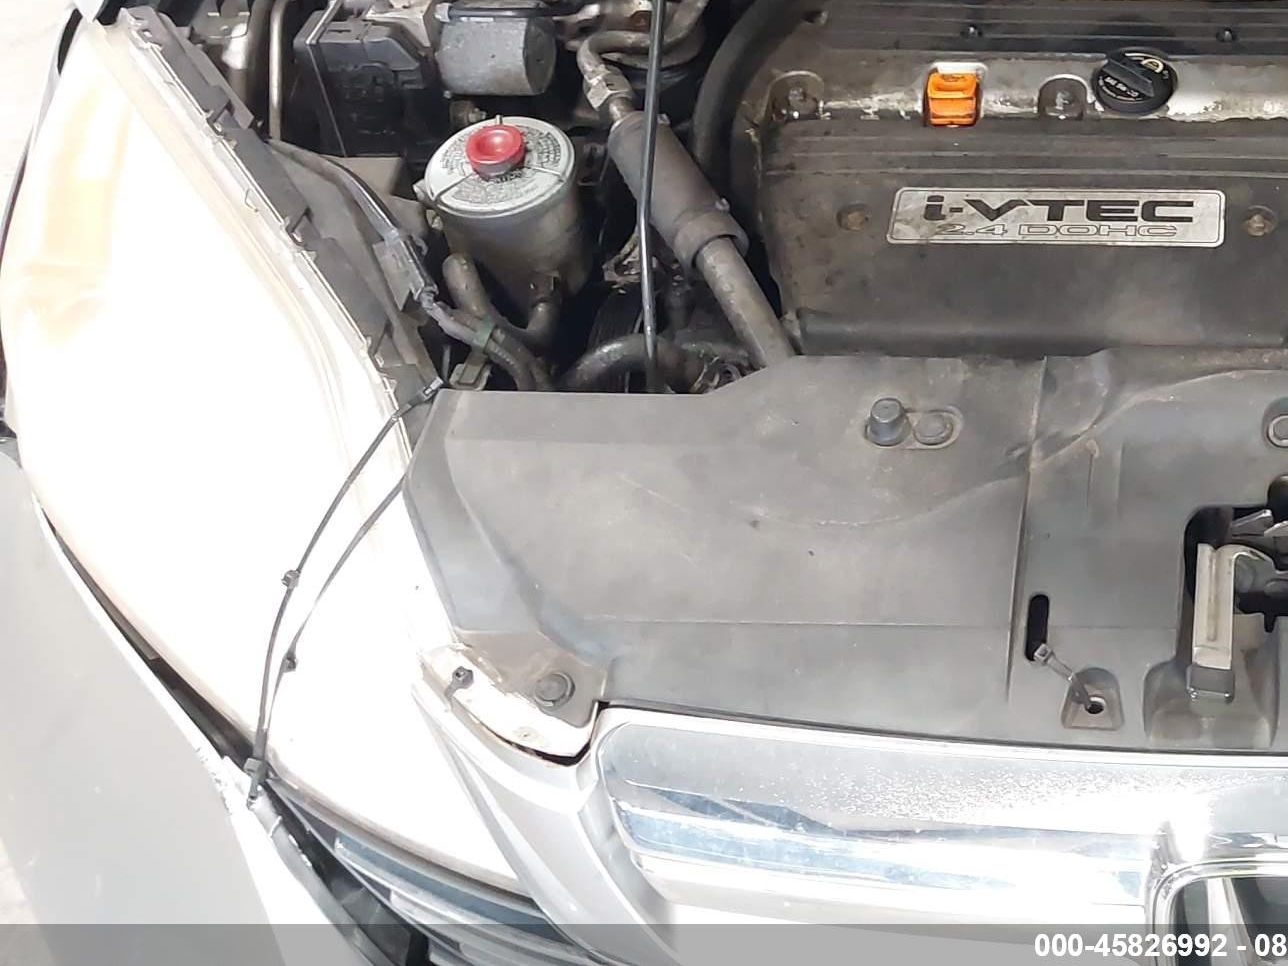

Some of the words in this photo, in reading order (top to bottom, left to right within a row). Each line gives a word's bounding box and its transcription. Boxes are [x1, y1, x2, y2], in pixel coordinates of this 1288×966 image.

[923, 194, 1195, 223] i-VTEC
[936, 223, 1008, 236] 2.4
[1017, 224, 1178, 237] DOHC
